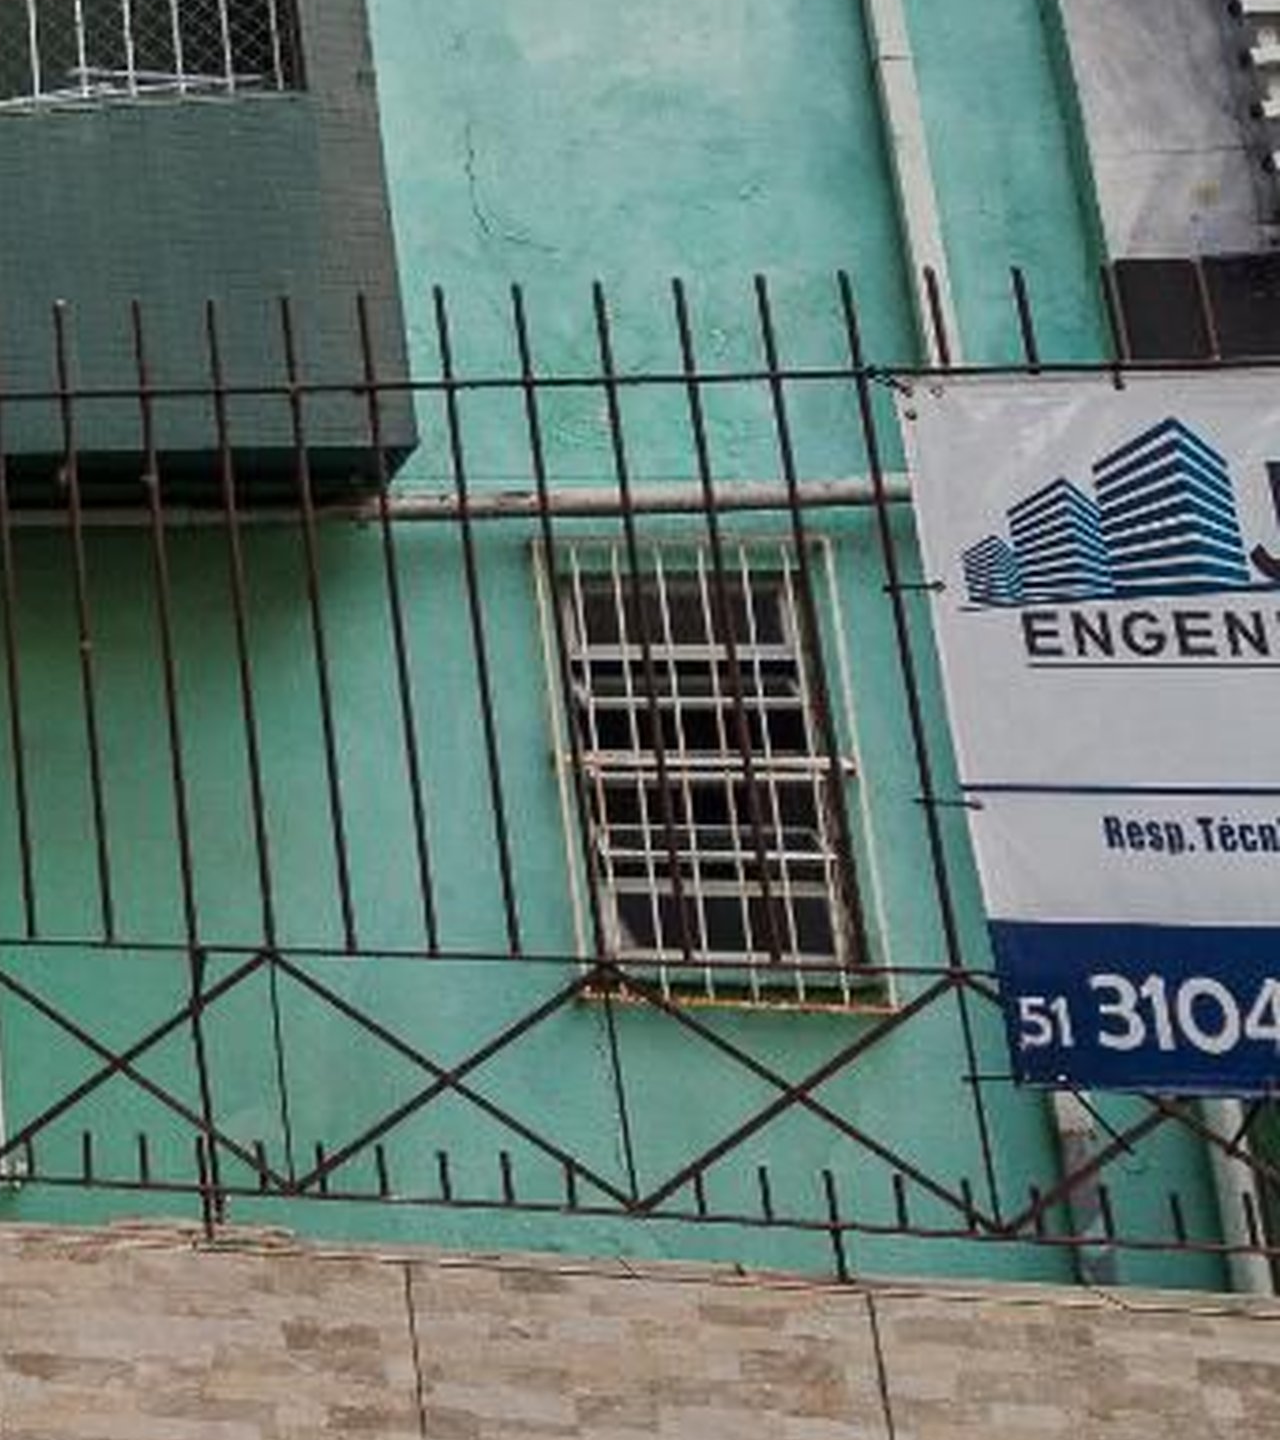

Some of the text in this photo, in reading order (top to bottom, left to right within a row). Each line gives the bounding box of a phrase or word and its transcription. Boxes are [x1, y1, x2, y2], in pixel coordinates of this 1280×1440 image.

[1021, 611, 1280, 657] ENGEN
[1103, 816, 1280, 855] Resp.Técn
[1019, 973, 1280, 1055] 51 3104
